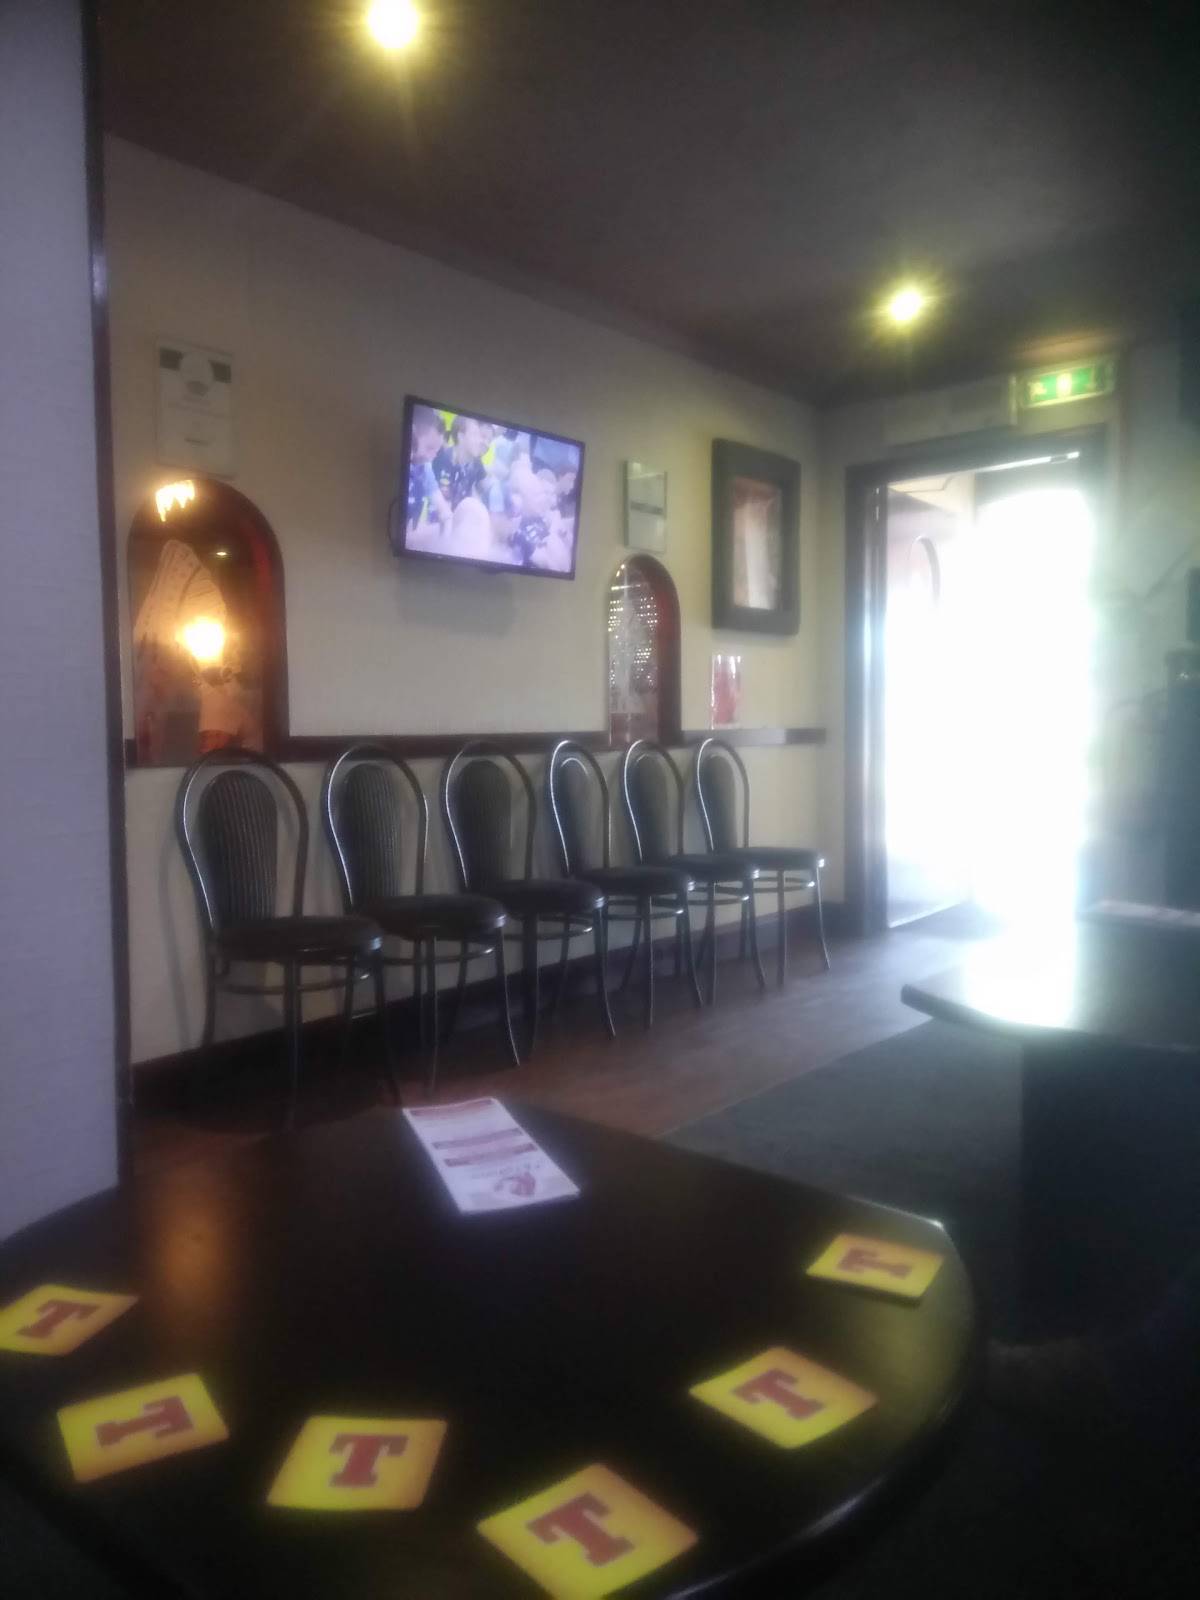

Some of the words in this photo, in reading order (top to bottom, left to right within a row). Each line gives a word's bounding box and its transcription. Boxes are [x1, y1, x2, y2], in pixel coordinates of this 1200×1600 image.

[837, 1247, 913, 1279] T
[17, 1300, 100, 1339] T
[732, 1369, 825, 1420] T
[96, 1396, 193, 1447] T
[329, 1433, 408, 1487] T
[526, 1492, 635, 1567] T
